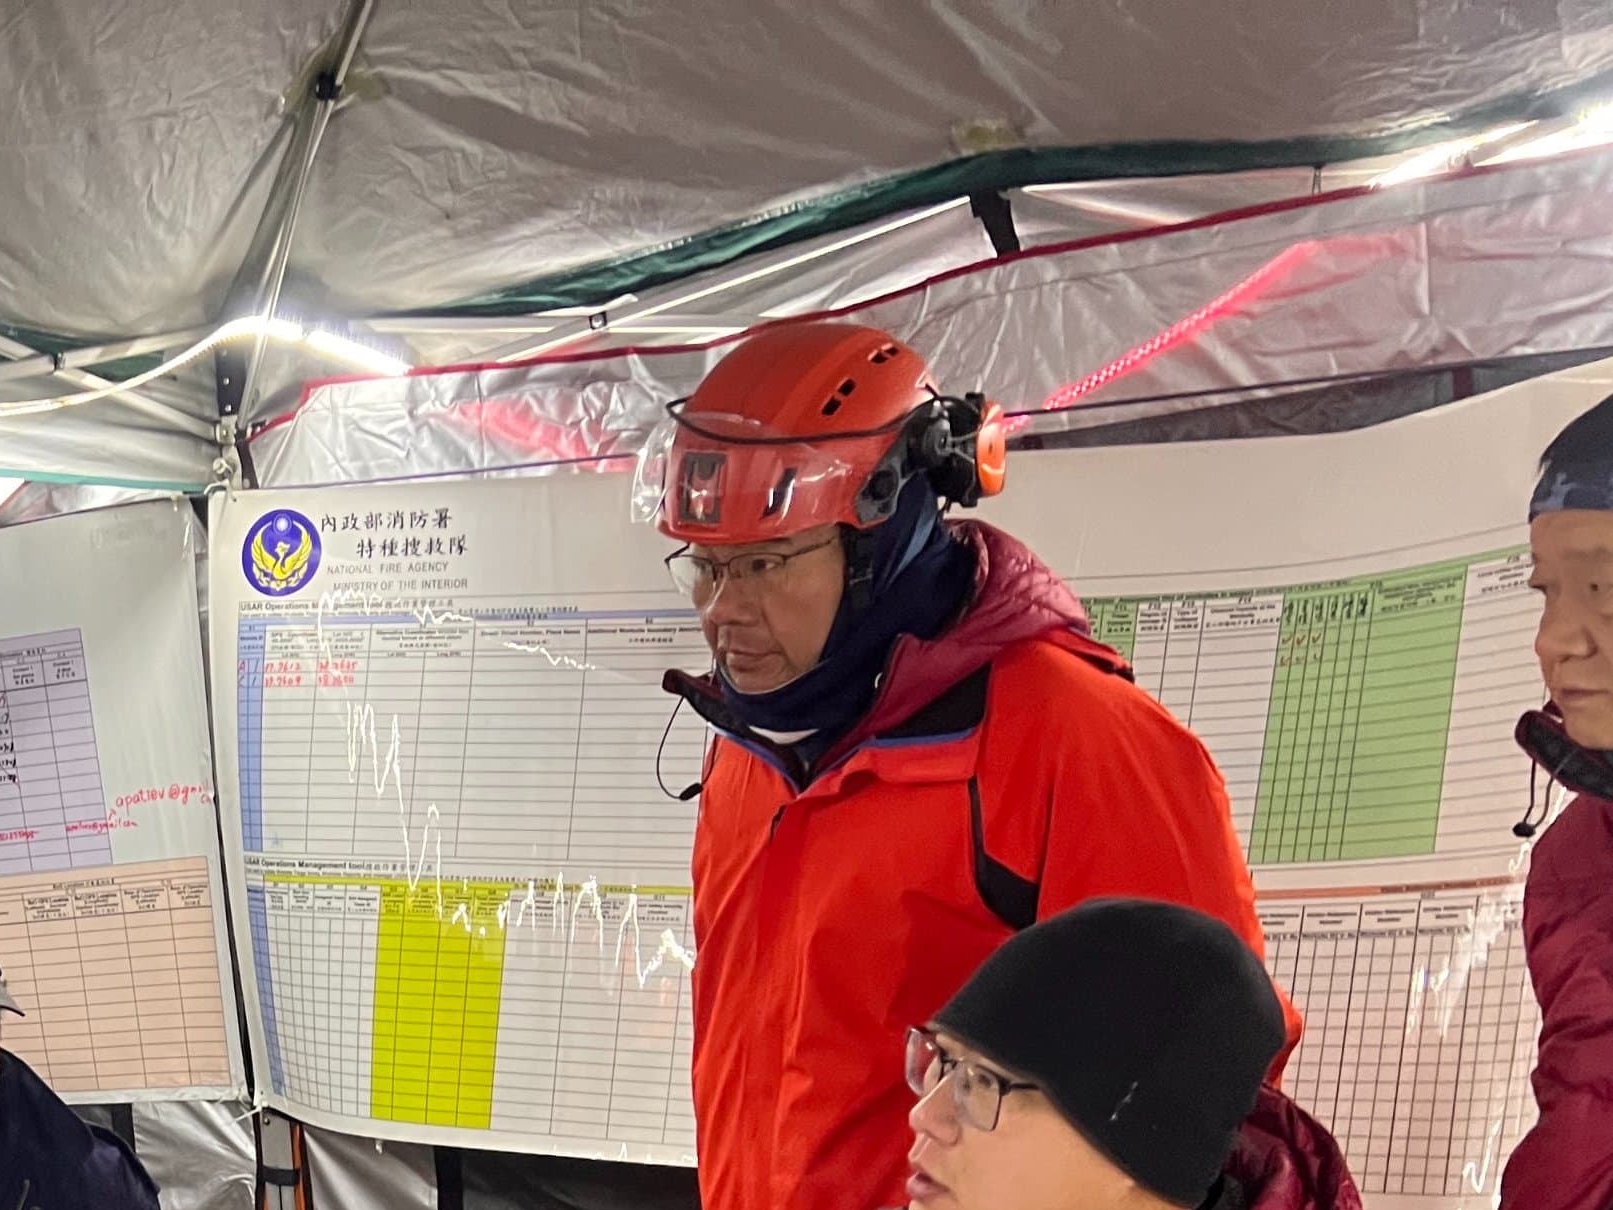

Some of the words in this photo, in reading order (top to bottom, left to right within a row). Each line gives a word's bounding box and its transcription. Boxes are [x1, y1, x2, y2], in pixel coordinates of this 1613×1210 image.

[327, 563, 373, 575] NATIONAL
[380, 562, 402, 573] FIRE
[407, 561, 449, 574] AGENCY
[333, 582, 379, 593] MINISTRY
[380, 580, 393, 591] OF
[399, 580, 418, 590] THE
[421, 578, 469, 590] INTERIOR
